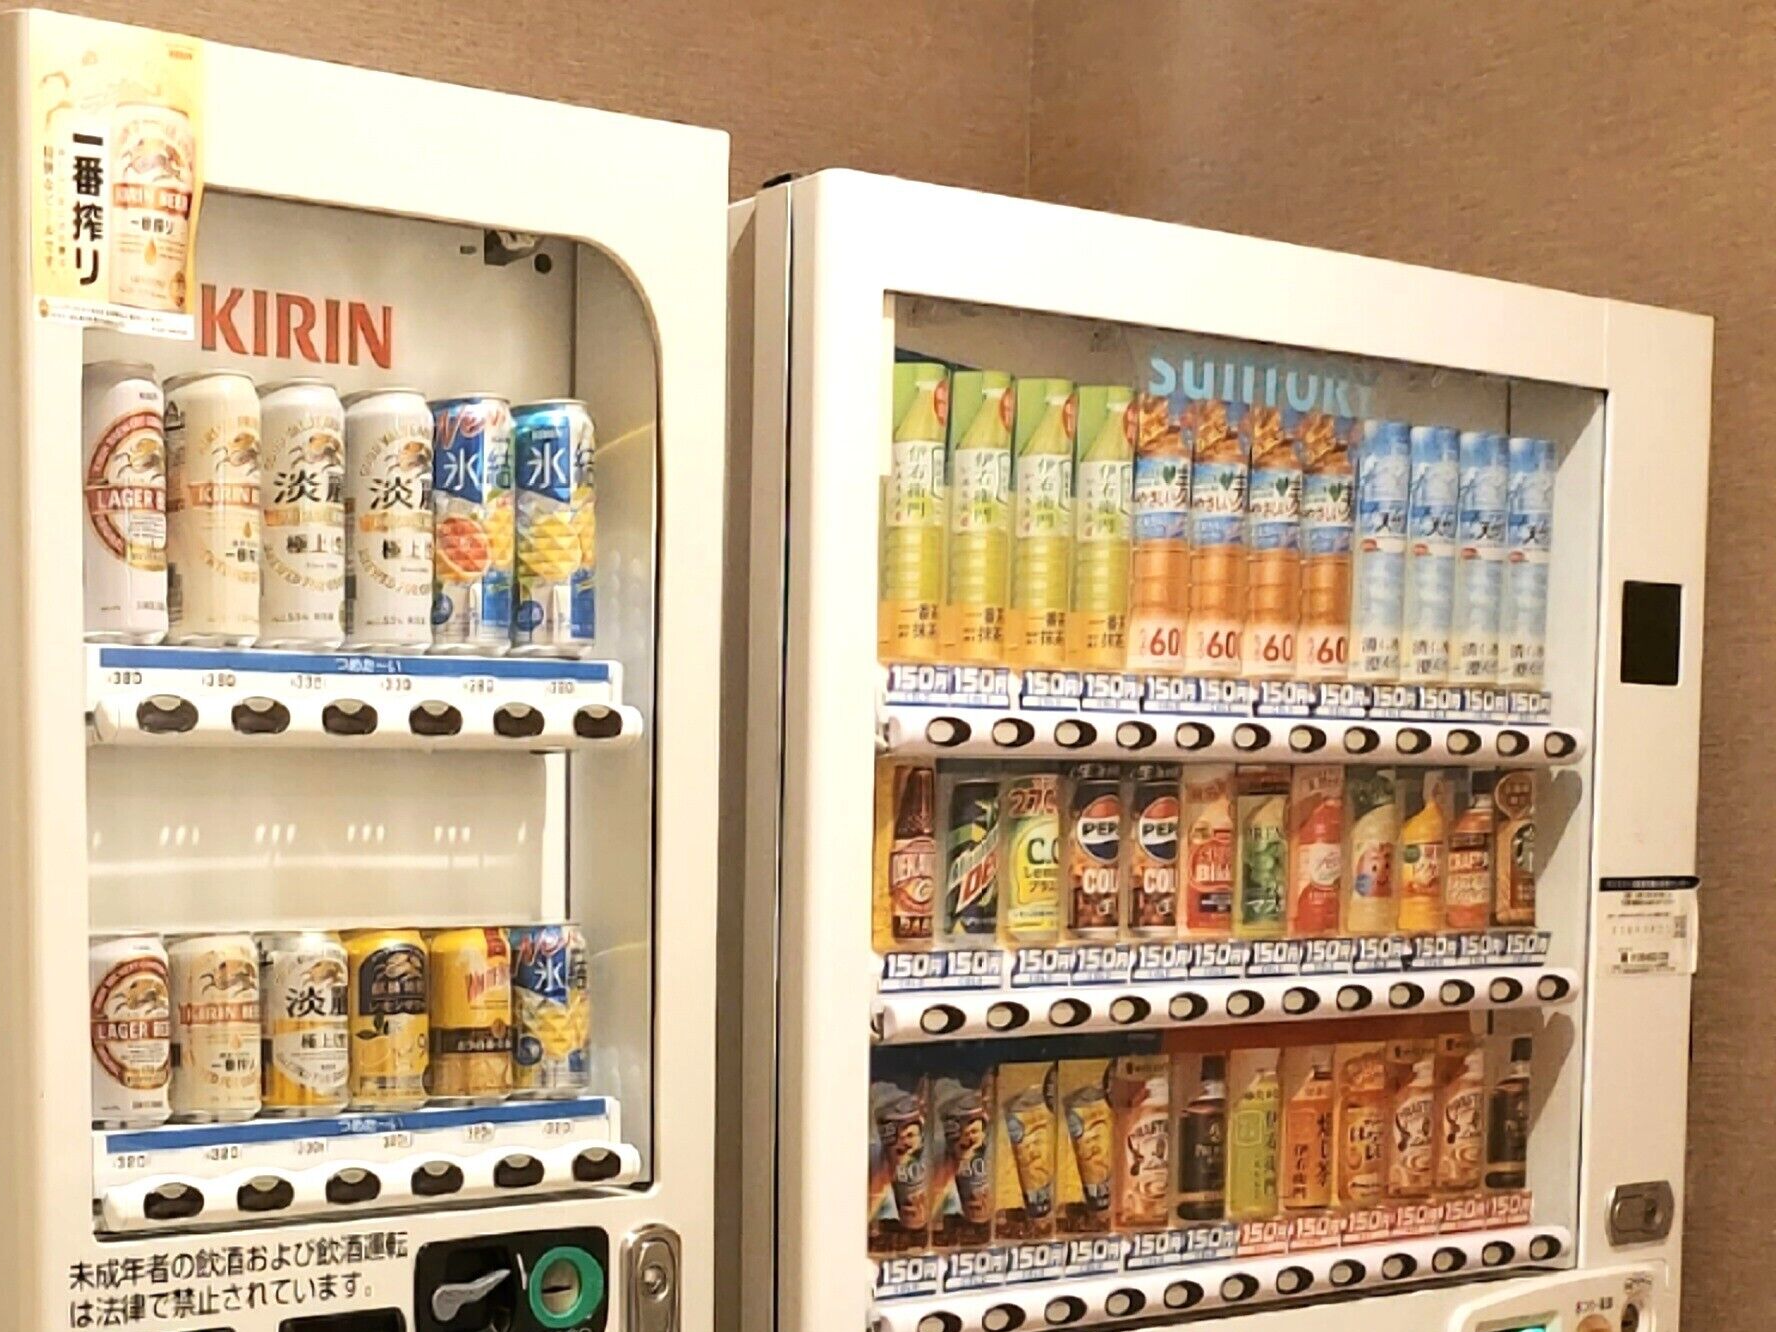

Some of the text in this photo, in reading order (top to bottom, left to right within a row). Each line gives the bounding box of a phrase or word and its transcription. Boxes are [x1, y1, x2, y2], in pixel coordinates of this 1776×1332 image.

[73, 132, 104, 286] 一番搾り
[201, 283, 393, 369] KIRIN
[97, 488, 158, 512] LAGER
[1083, 867, 1117, 895] COL
[1144, 867, 1175, 895] COL
[98, 1023, 148, 1040] LAGER
[69, 1231, 409, 1290] 未成年者の飲酒および飲酒運転
[69, 1272, 374, 1328] は法律で禁止されています。
